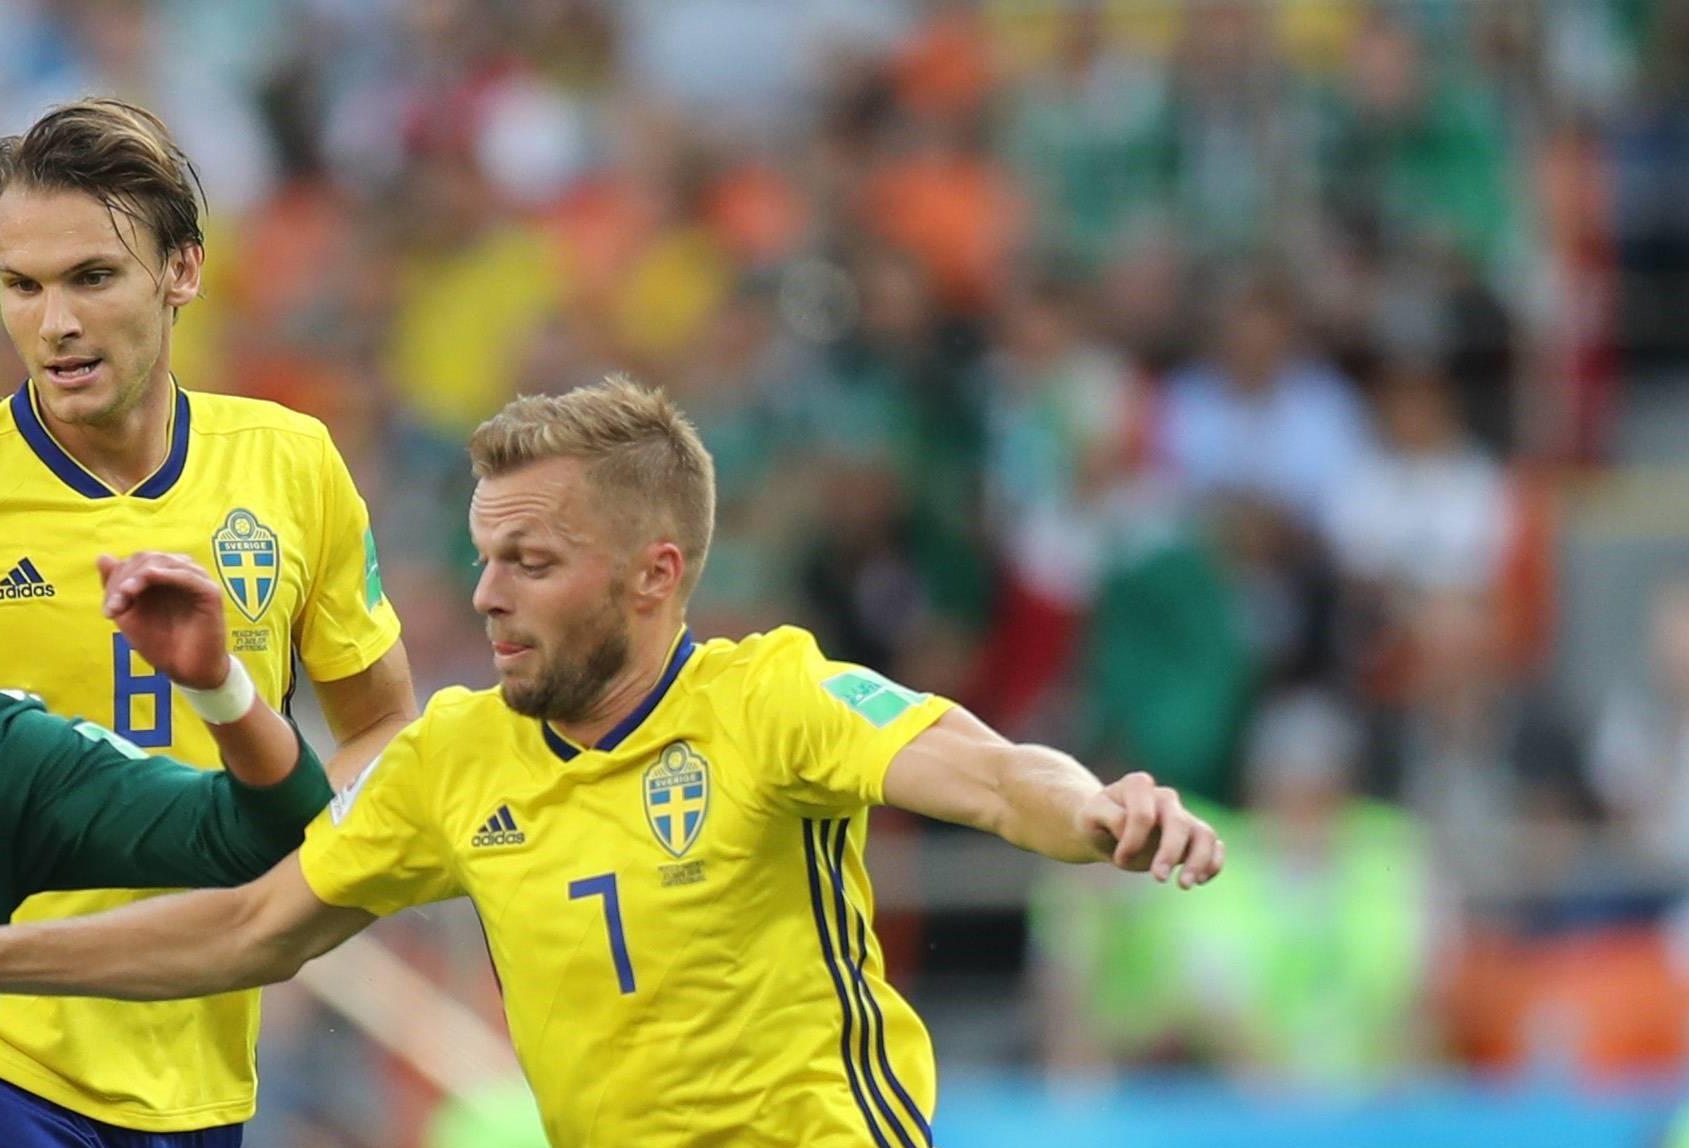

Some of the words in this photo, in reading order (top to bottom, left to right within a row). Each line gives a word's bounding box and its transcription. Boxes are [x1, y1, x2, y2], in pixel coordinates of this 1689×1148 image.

[224, 541, 267, 550] SVERIGE
[113, 631, 173, 748] 8
[471, 831, 525, 848] adidas
[568, 872, 636, 995] 7
